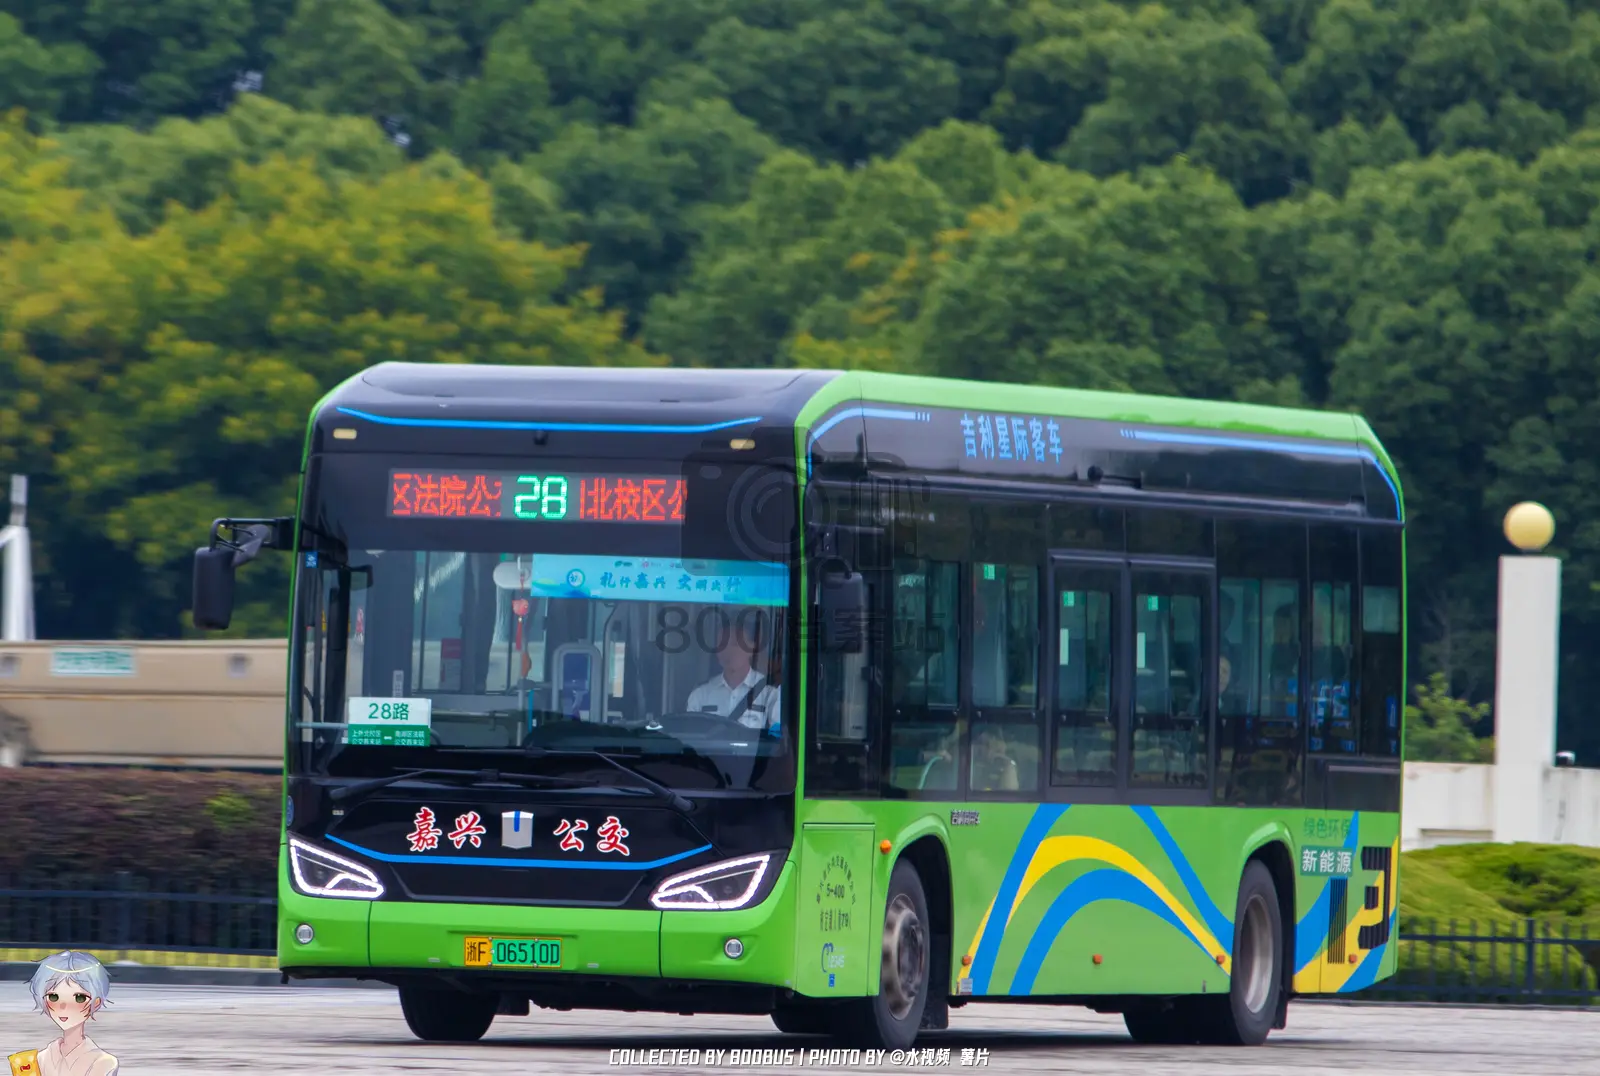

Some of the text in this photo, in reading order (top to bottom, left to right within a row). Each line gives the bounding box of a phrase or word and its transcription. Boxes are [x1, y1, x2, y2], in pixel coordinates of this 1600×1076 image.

[960, 412, 1063, 463] 吉利星际客车
[393, 473, 502, 516] 区法院公
[514, 475, 568, 519] 28
[368, 702, 409, 720] 28路
[406, 807, 630, 856] 嘉兴 公交
[1302, 849, 1352, 873] 新能源
